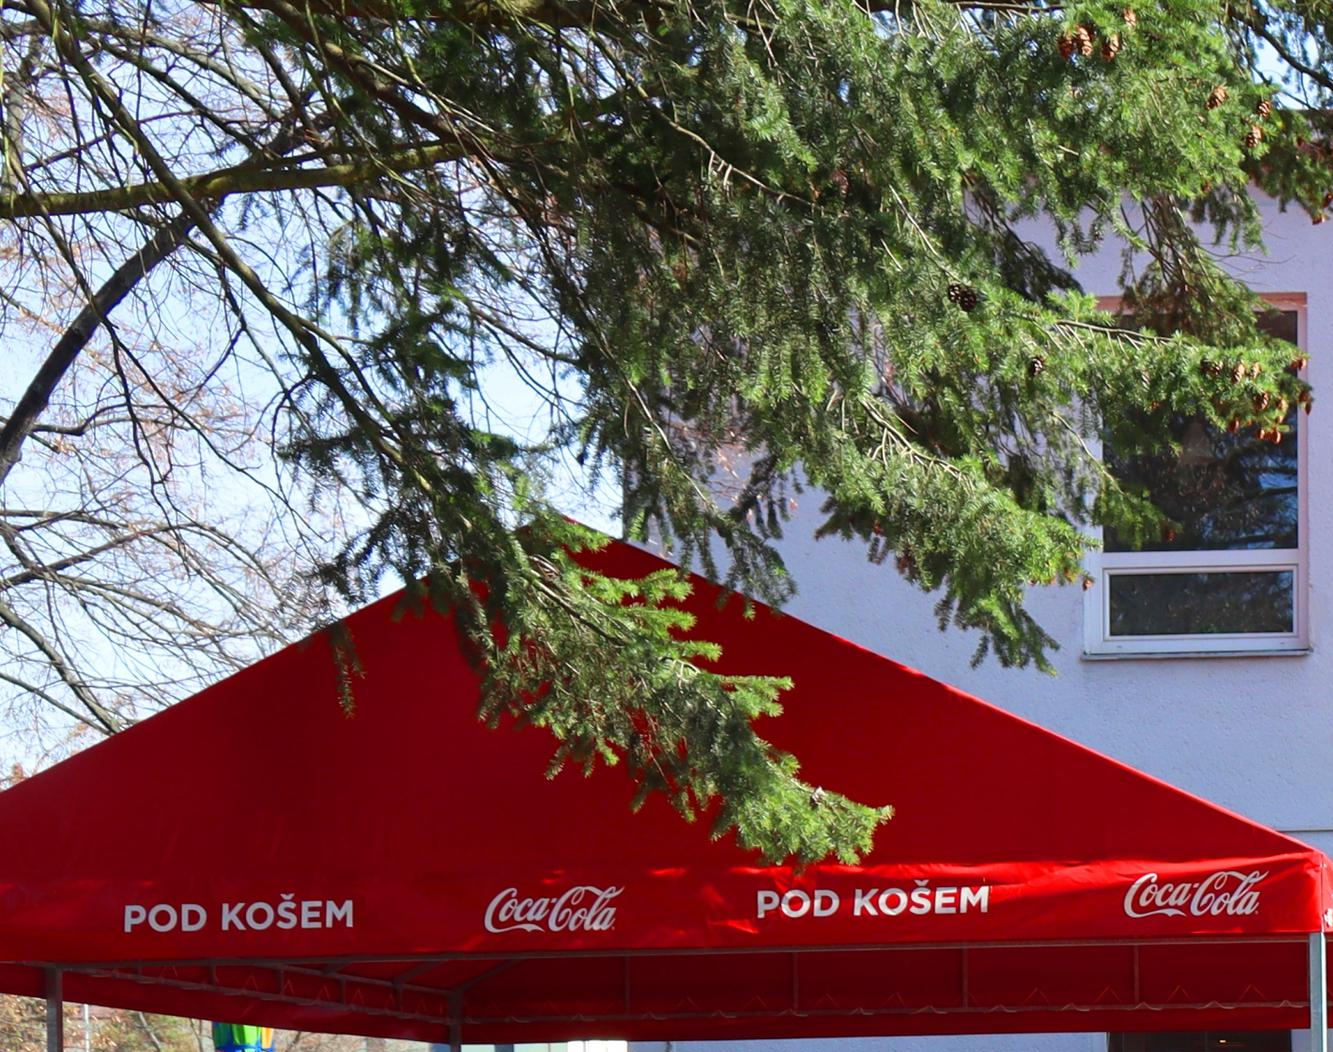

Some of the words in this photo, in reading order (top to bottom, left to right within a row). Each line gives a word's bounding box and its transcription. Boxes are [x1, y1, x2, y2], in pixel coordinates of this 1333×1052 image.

[124, 903, 206, 933] POD
[221, 892, 354, 931] KOŠEM
[484, 885, 625, 933] Coca-Cola
[756, 888, 840, 919] POD
[853, 879, 990, 917] KOŠEM
[1124, 870, 1270, 918] Coca-Cola
